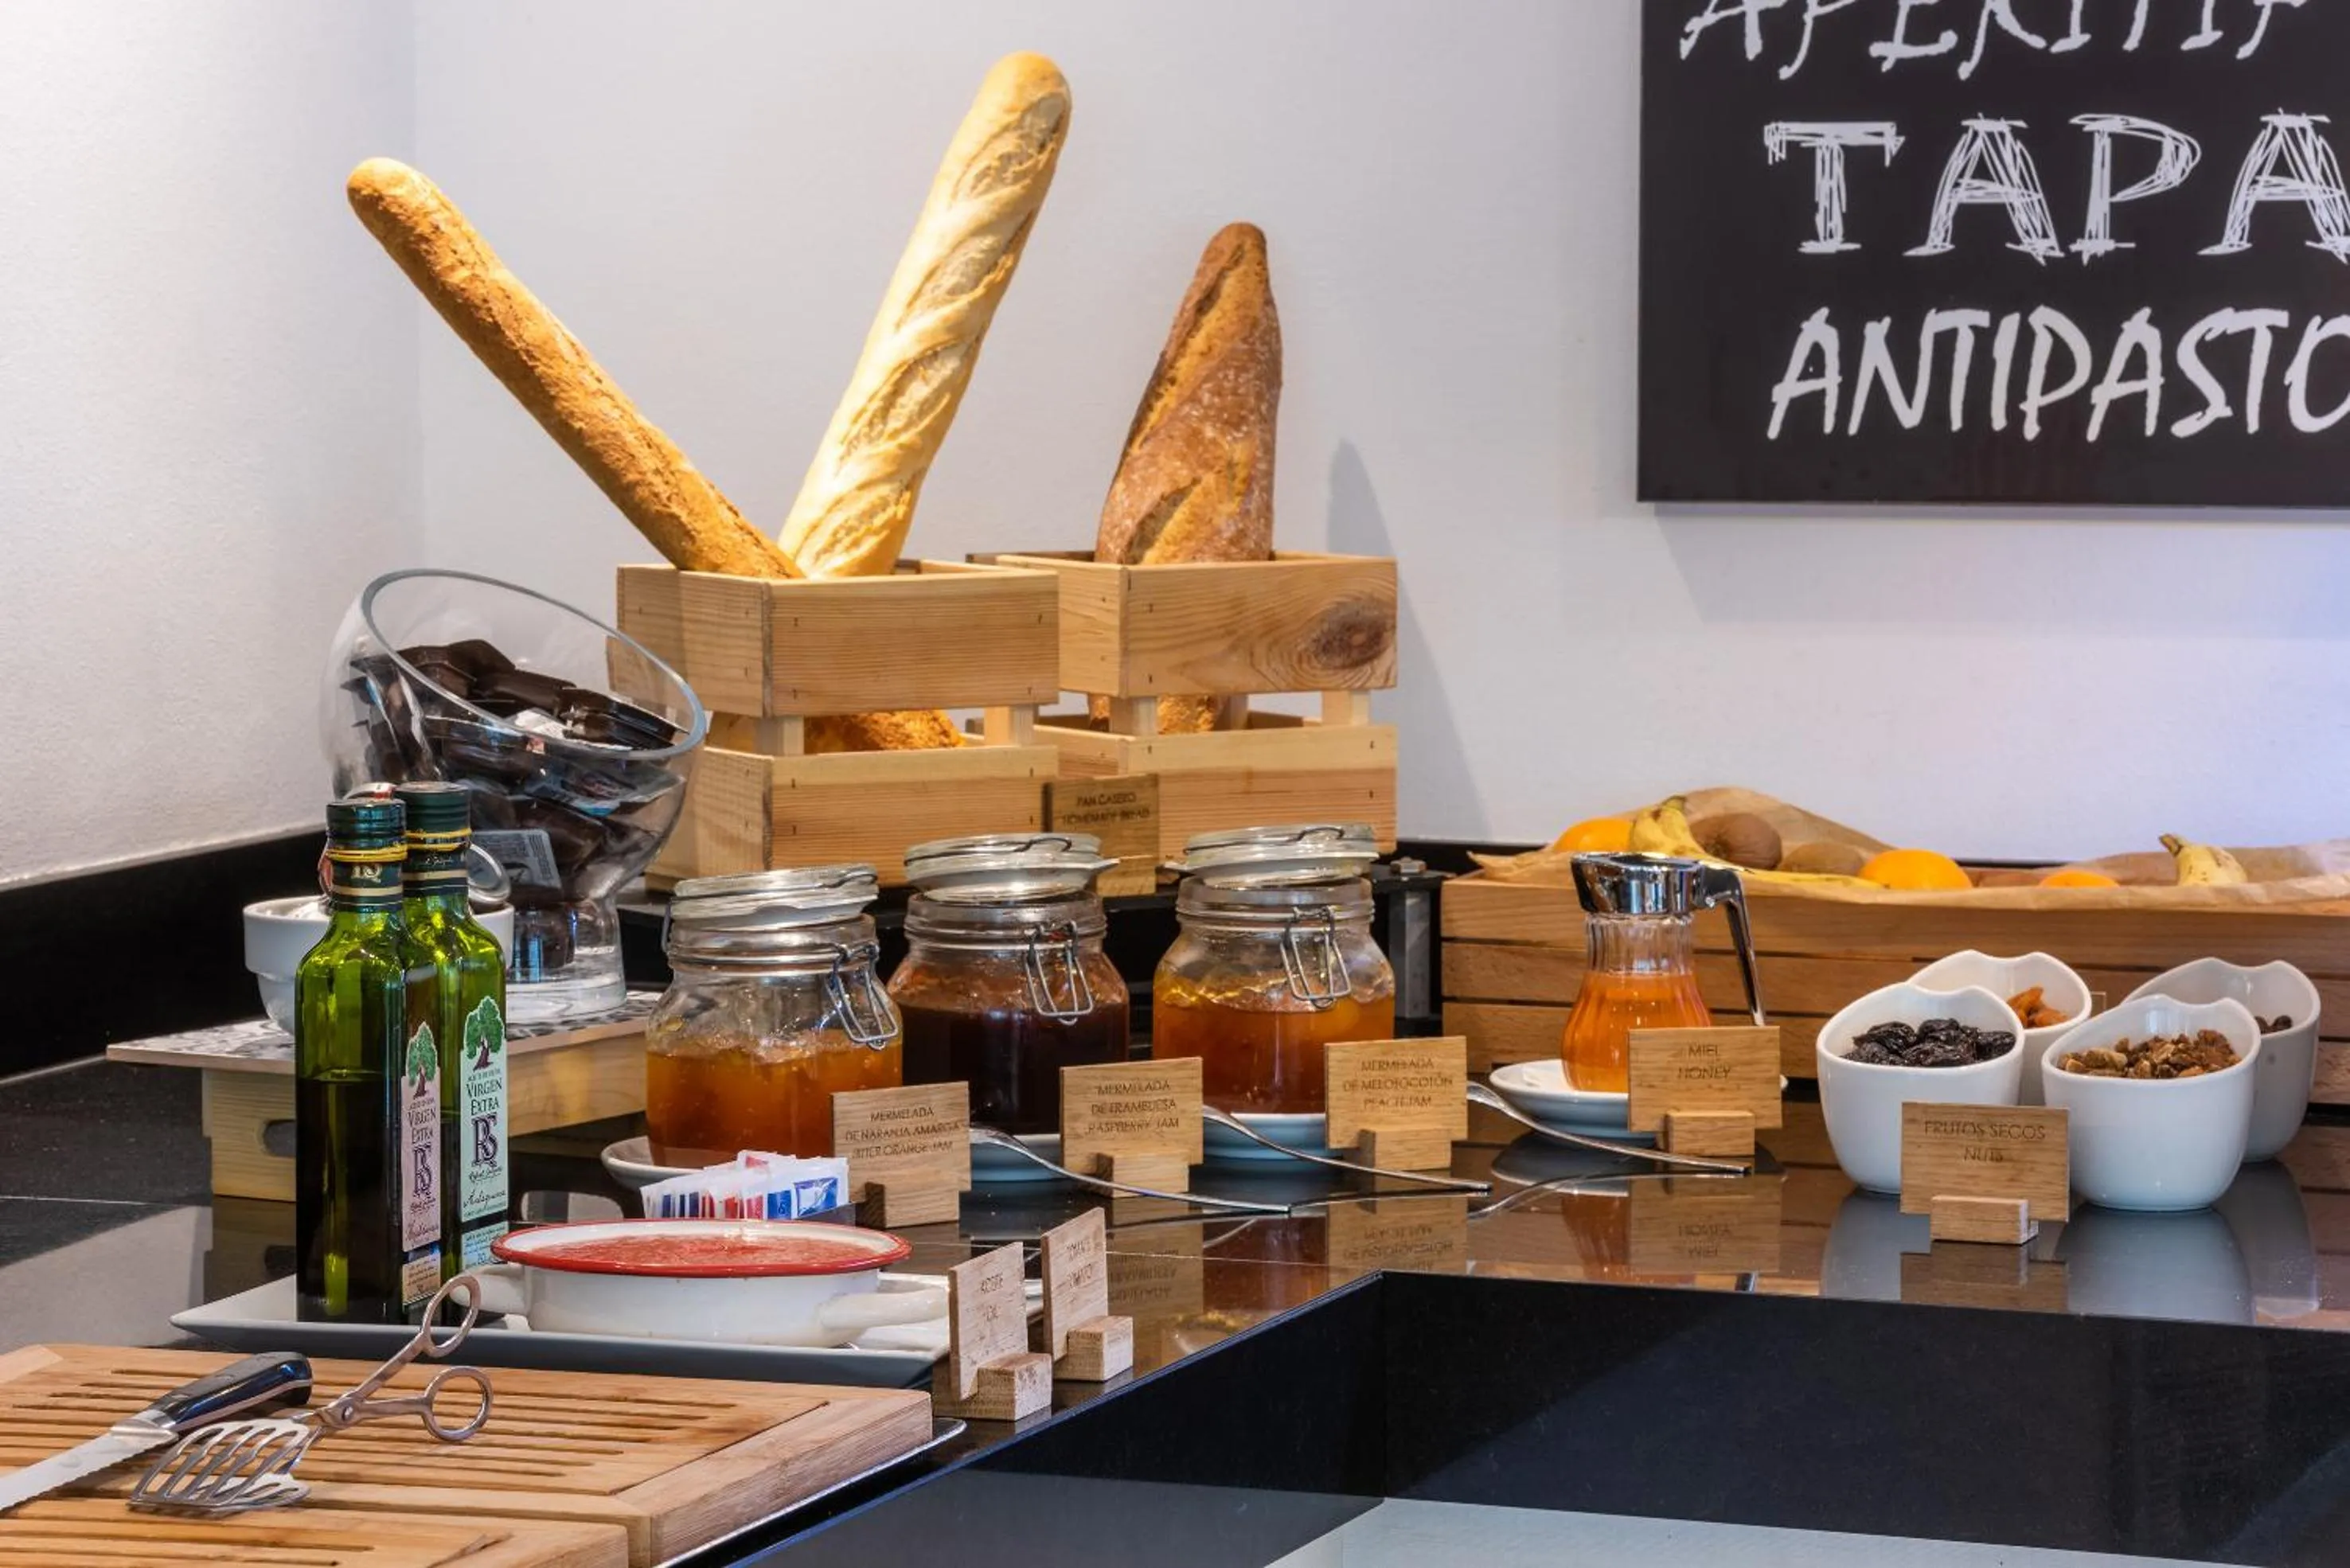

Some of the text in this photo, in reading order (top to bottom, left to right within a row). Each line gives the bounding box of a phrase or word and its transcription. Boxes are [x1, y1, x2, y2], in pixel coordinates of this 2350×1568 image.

[1766, 304, 2350, 441] ANTIPASTO
[1688, 1043, 1719, 1057] MIEL
[1678, 1064, 1731, 1079] HONEY
[466, 1078, 502, 1098] VIRGEN
[1095, 1079, 1171, 1096] MERMELADA
[471, 1097, 499, 1116] EXTRA
[869, 1106, 935, 1122] MERMELADA
[408, 1107, 436, 1127] VIRGEN
[412, 1126, 434, 1144] EXTRA
[1923, 1119, 2046, 1140] FRUTOS SECOS
[1963, 1146, 2005, 1162] NUTS
